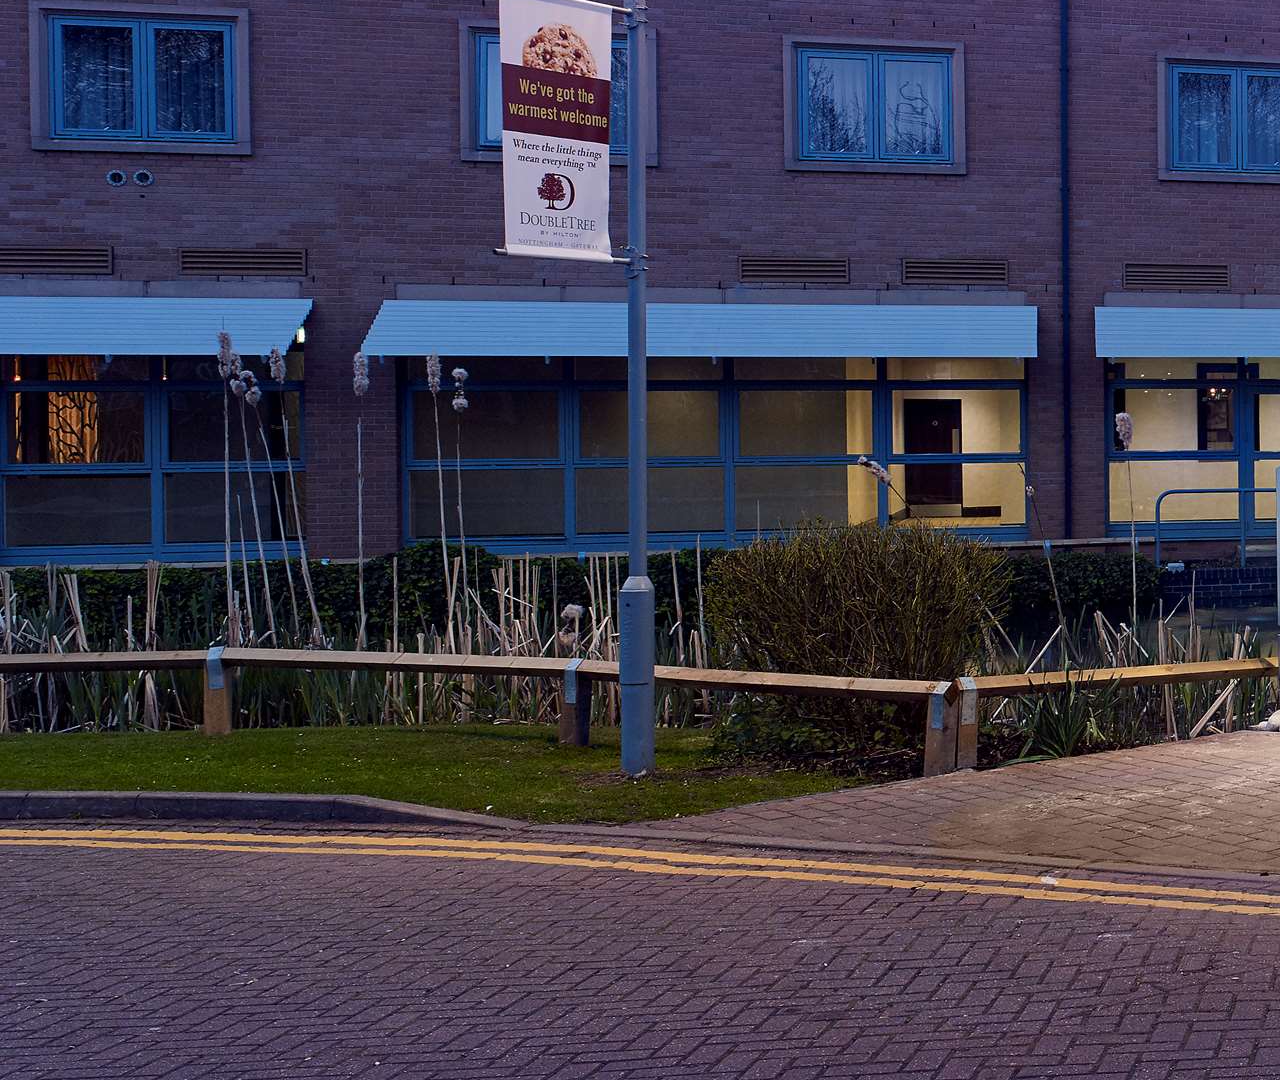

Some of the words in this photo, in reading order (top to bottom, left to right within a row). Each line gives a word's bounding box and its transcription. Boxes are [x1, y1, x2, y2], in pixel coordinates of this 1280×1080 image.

[519, 78, 553, 98] We've
[556, 87, 577, 102] got
[578, 88, 595, 104] the
[508, 102, 557, 121] warmest
[560, 109, 608, 128] welcome
[513, 138, 540, 151] Where
[541, 142, 555, 153] the
[556, 143, 576, 155] little
[577, 148, 602, 161] things
[517, 154, 540, 164] mean
[541, 157, 584, 171] everything
